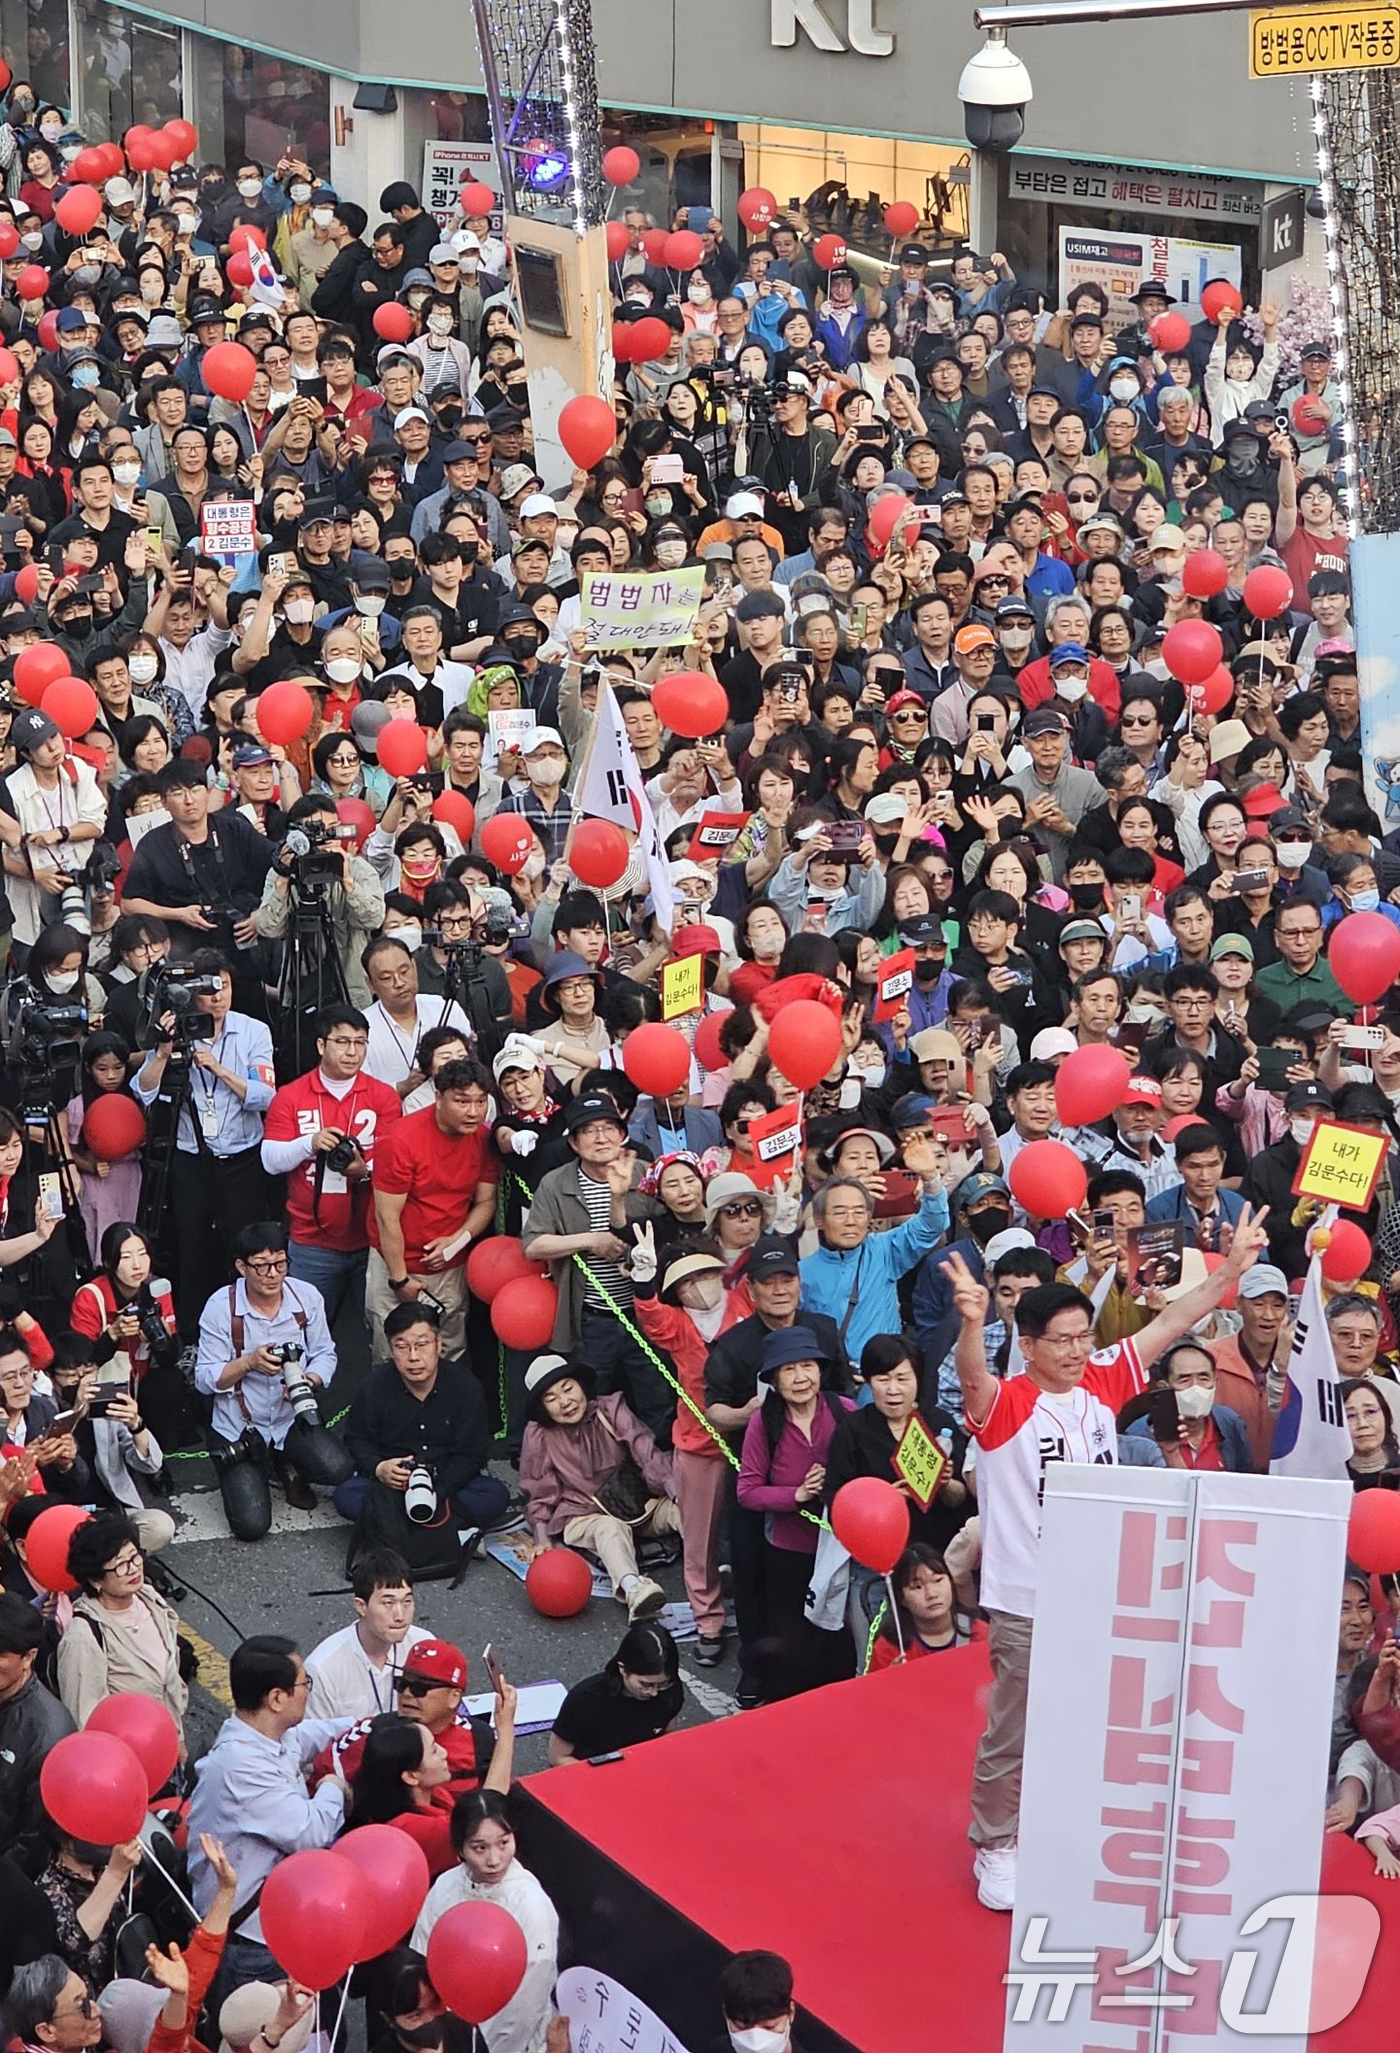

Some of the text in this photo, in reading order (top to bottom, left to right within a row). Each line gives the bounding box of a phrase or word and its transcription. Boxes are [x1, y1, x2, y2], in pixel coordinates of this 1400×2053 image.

[1260, 21, 1395, 66] 방범용CCTV작동중
[431, 167, 454, 185] 꼭!
[1014, 170, 1218, 211] 부담은 접고 혜택은 펼치고
[1273, 213, 1293, 253] kt
[1066, 242, 1109, 257] USIM재고
[207, 506, 251, 519] 대통령은
[208, 536, 251, 549] 2 김문수
[674, 967, 690, 983] 내가
[886, 975, 909, 995] 김문수
[665, 983, 699, 1006] 김문수다!
[765, 1131, 797, 1154] 김문수
[1332, 1141, 1361, 1162] 내가
[1308, 1160, 1369, 1189] 김문수다!
[910, 1426, 939, 1470] 대통령
